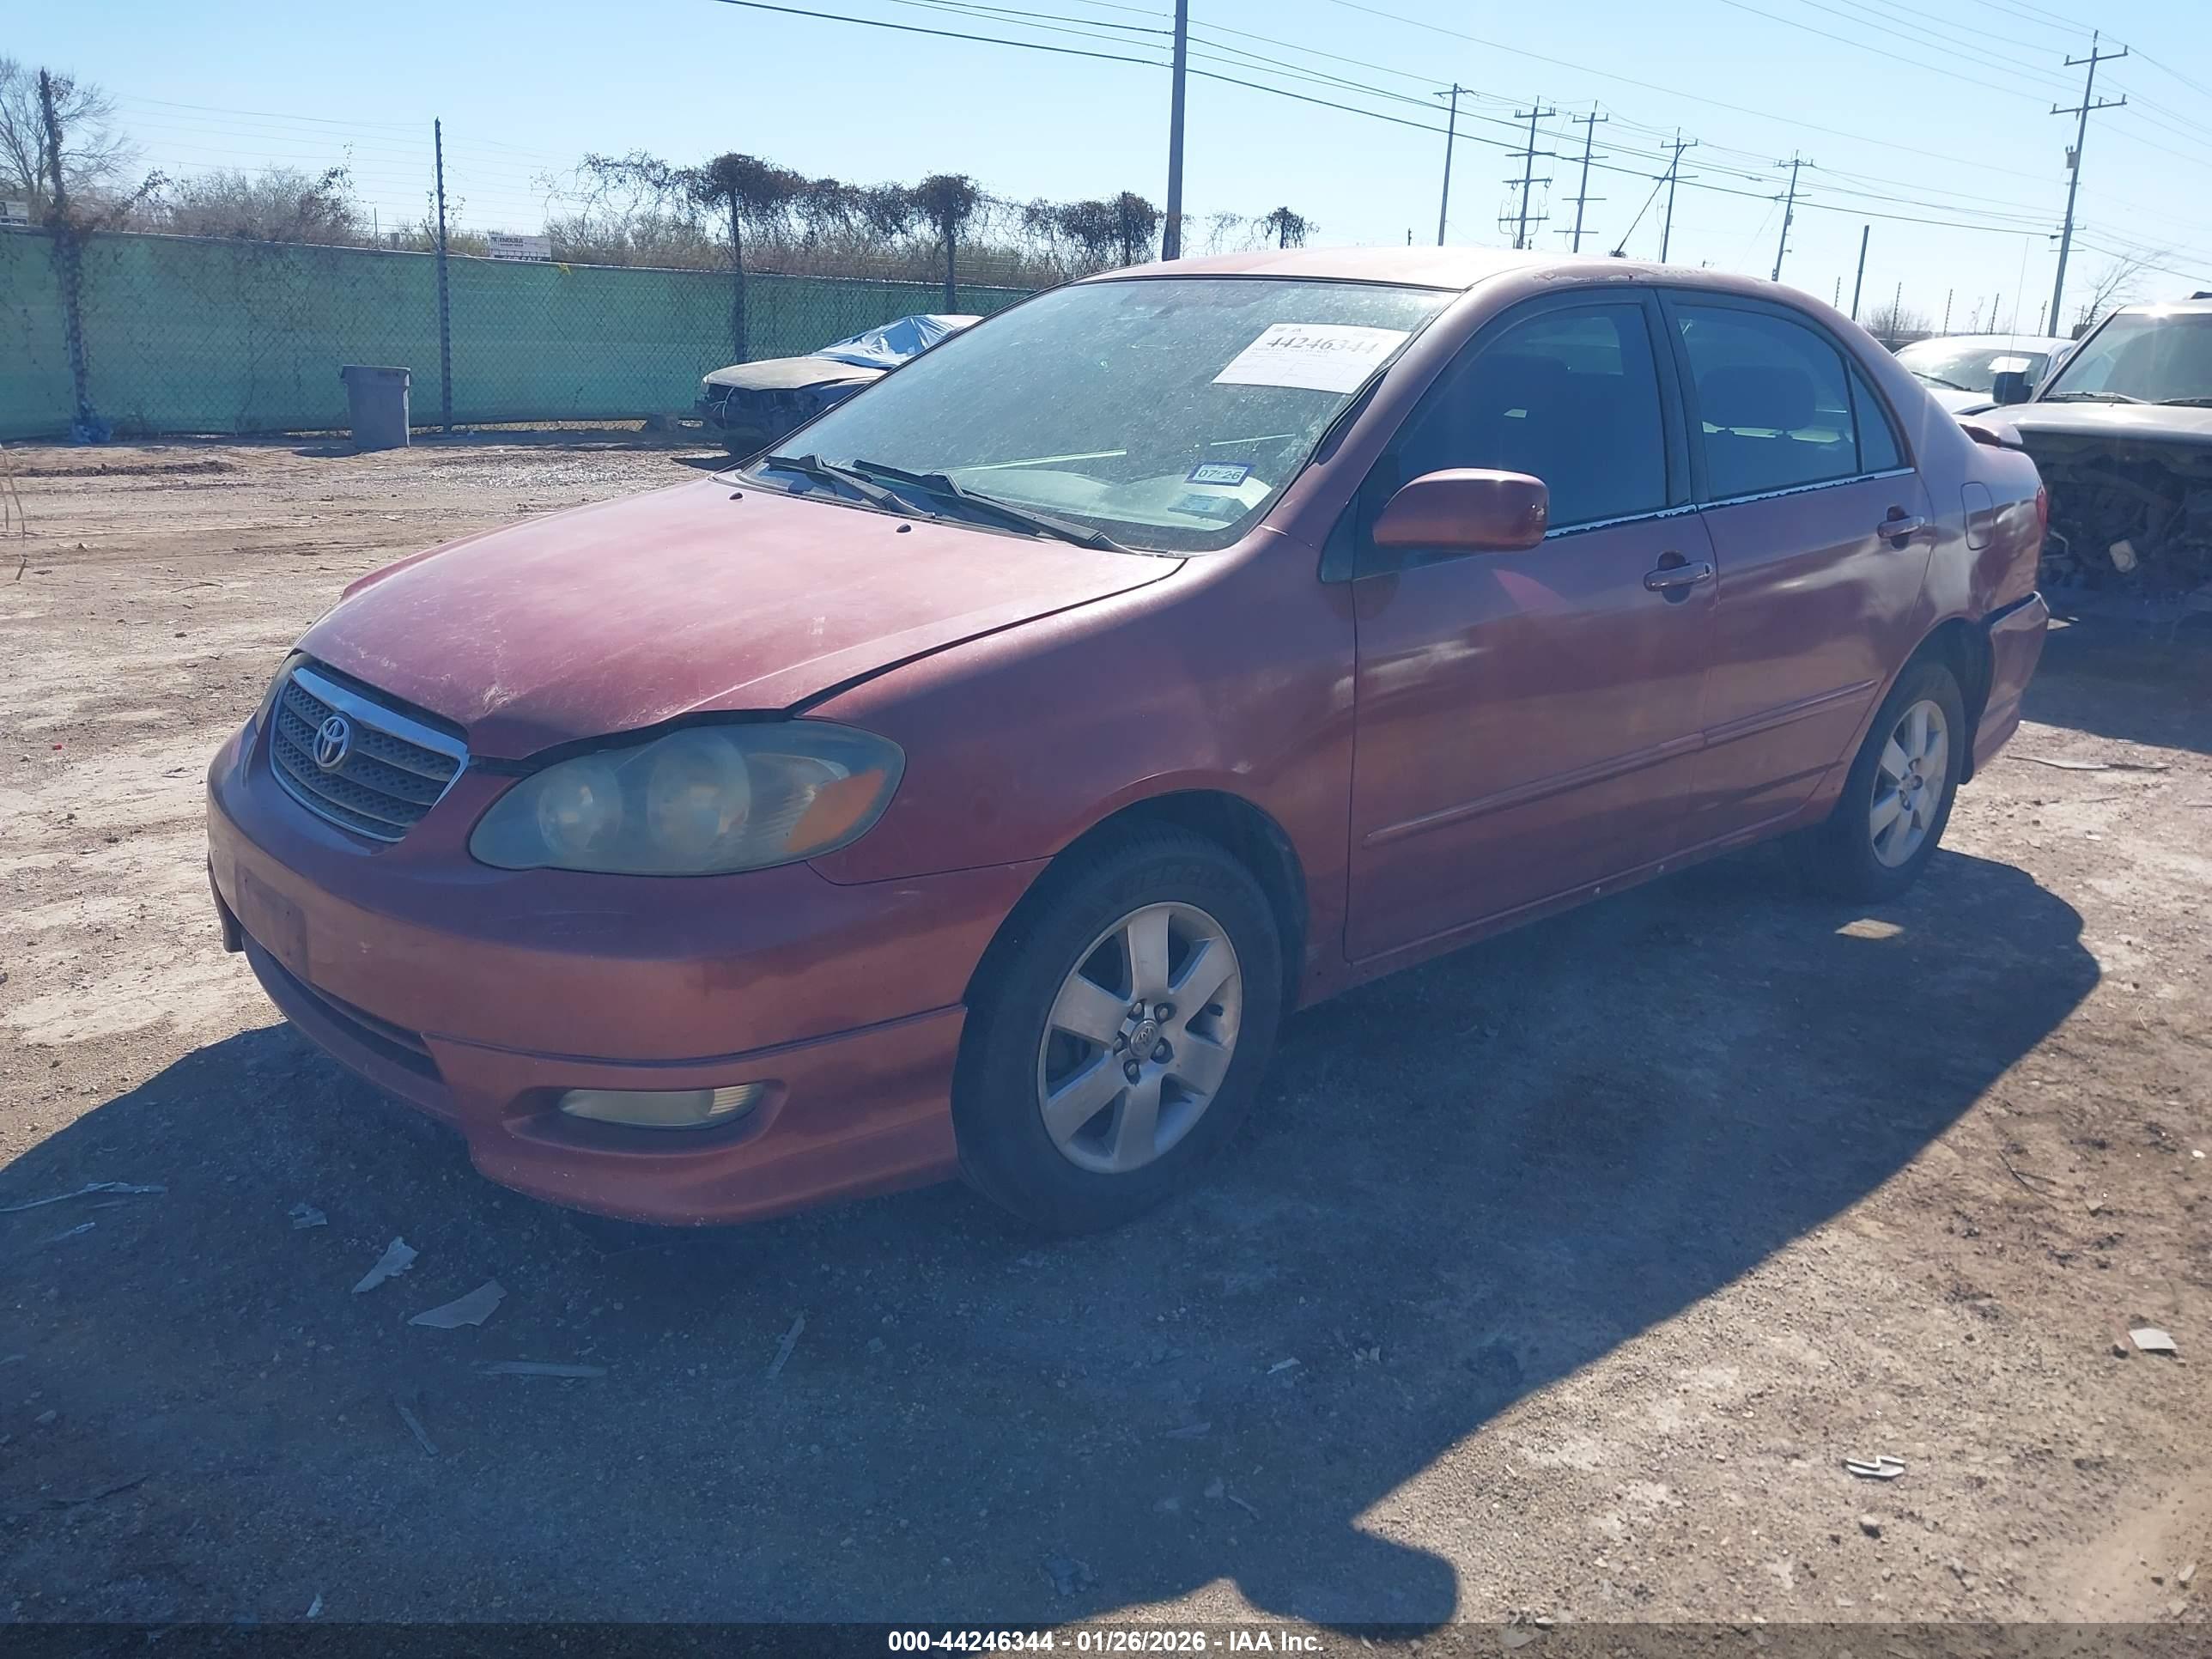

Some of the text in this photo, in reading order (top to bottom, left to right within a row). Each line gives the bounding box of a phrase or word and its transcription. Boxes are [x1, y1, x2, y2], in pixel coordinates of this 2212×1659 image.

[1267, 336, 1379, 354] 44246344
[1198, 469, 1243, 480] 07 26
